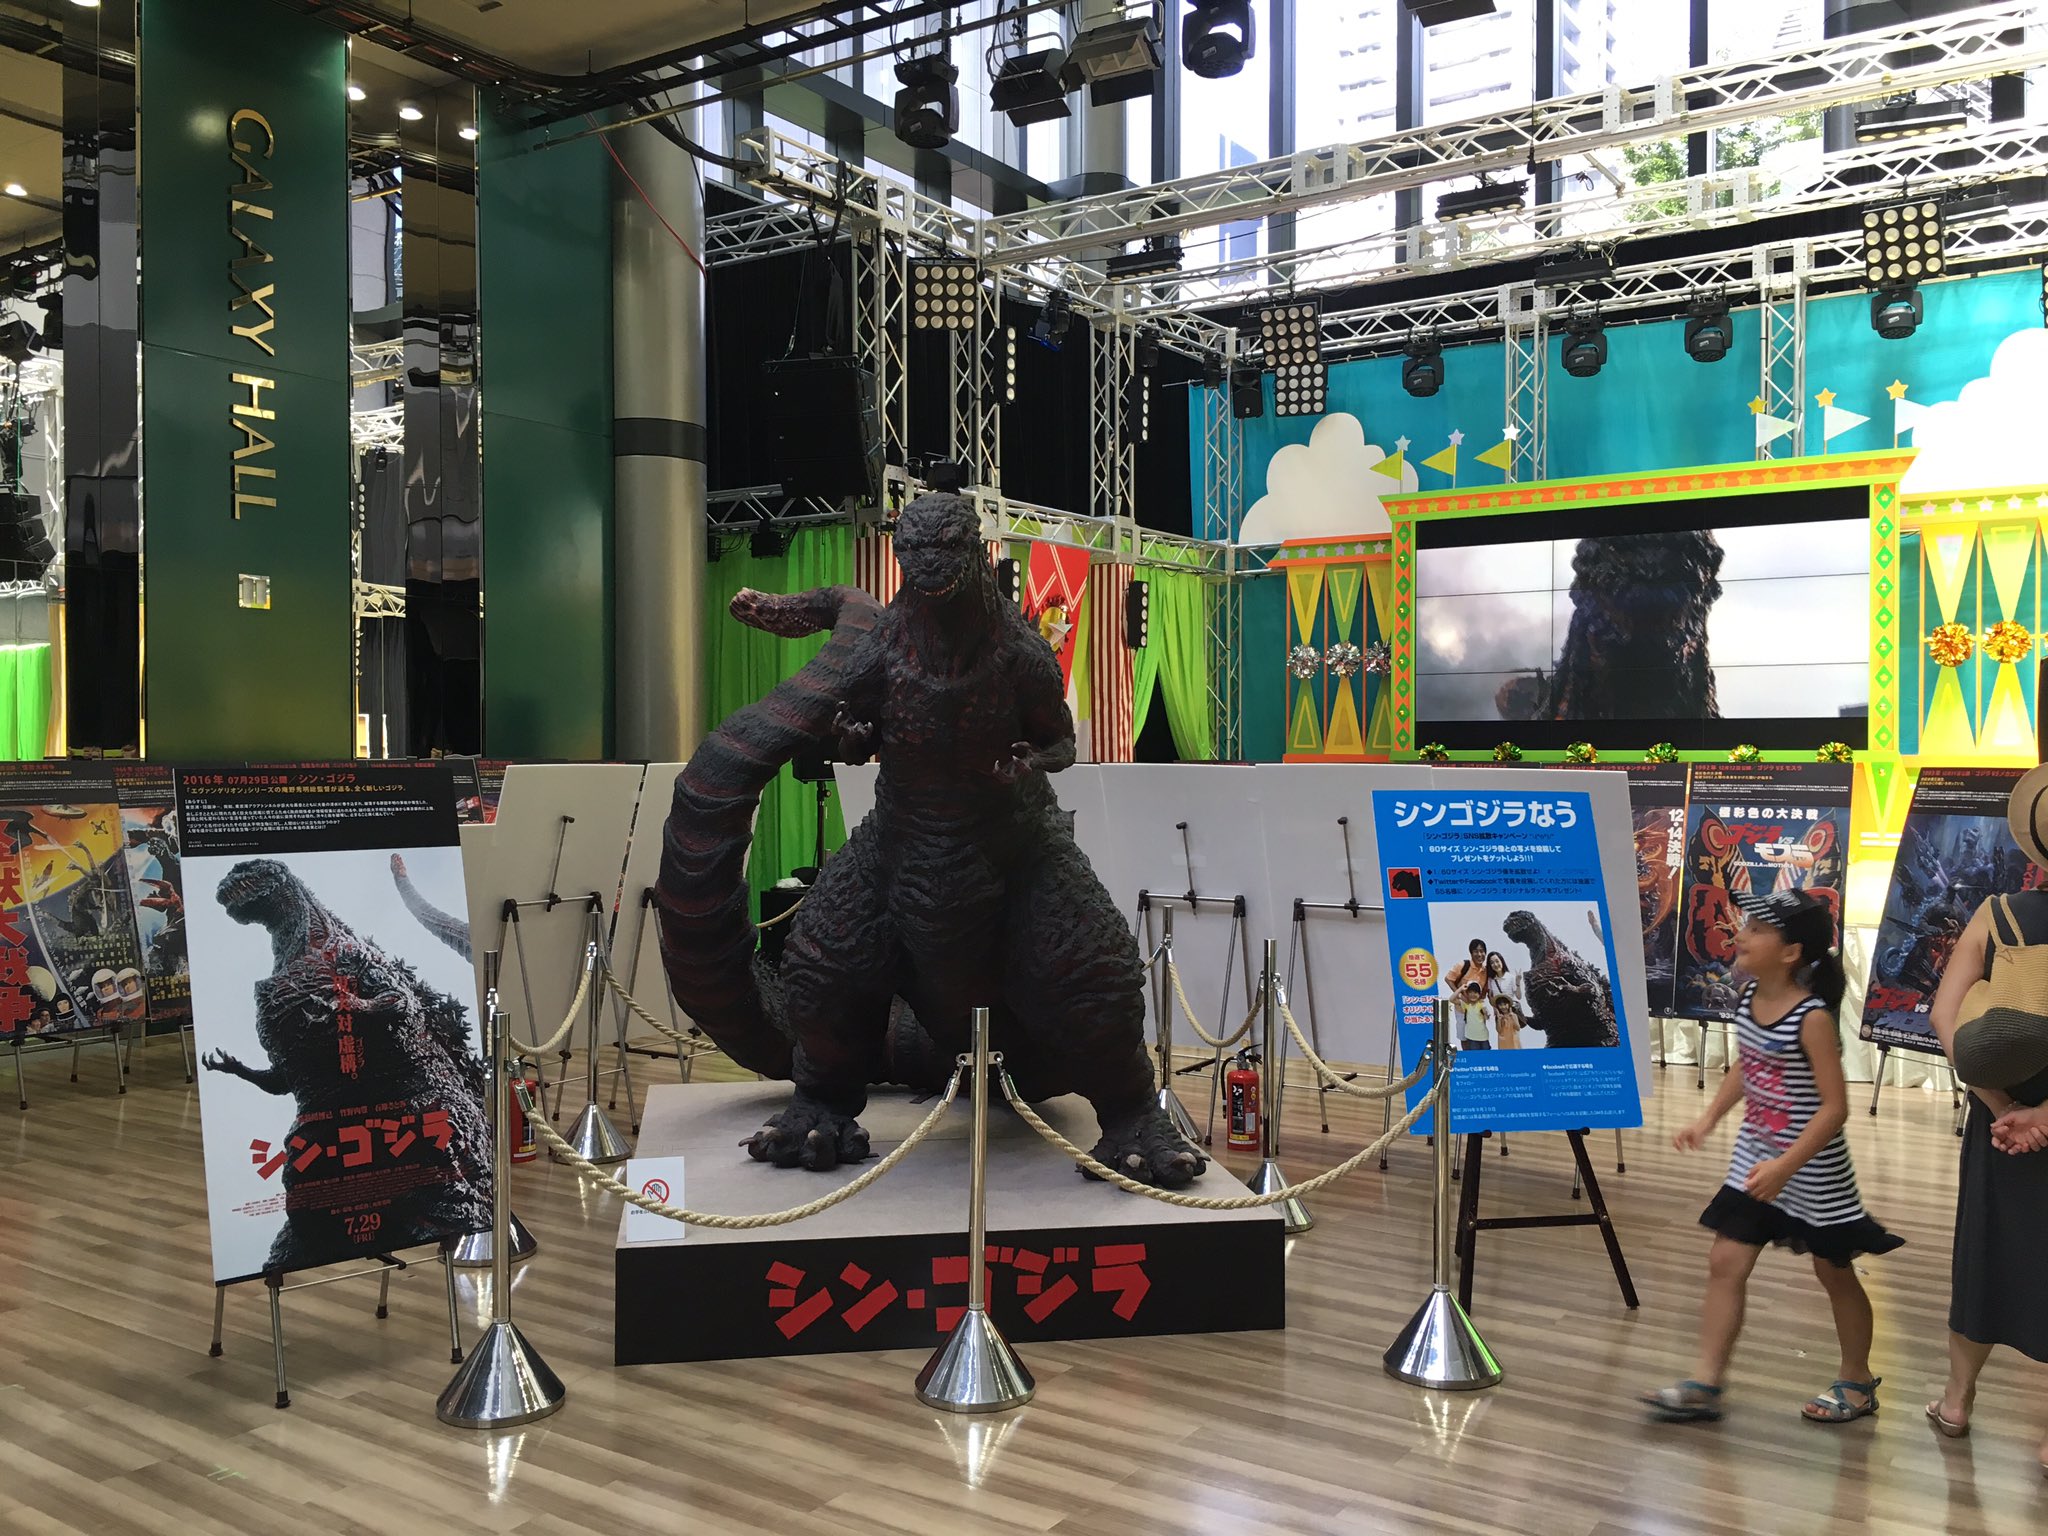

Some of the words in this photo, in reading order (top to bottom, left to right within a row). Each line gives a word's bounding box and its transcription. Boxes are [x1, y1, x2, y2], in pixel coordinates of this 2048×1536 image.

[230, 108, 276, 356] GALAXY
[231, 372, 277, 520] HALL
[183, 774, 224, 785] 2016年
[1394, 800, 1577, 829] シンゴジラなう
[1405, 963, 1432, 978] 55
[249, 1110, 456, 1181] シン・ゴジラ
[344, 1212, 381, 1236] 7.29
[764, 1243, 1152, 1341] シン・ゴジラ
